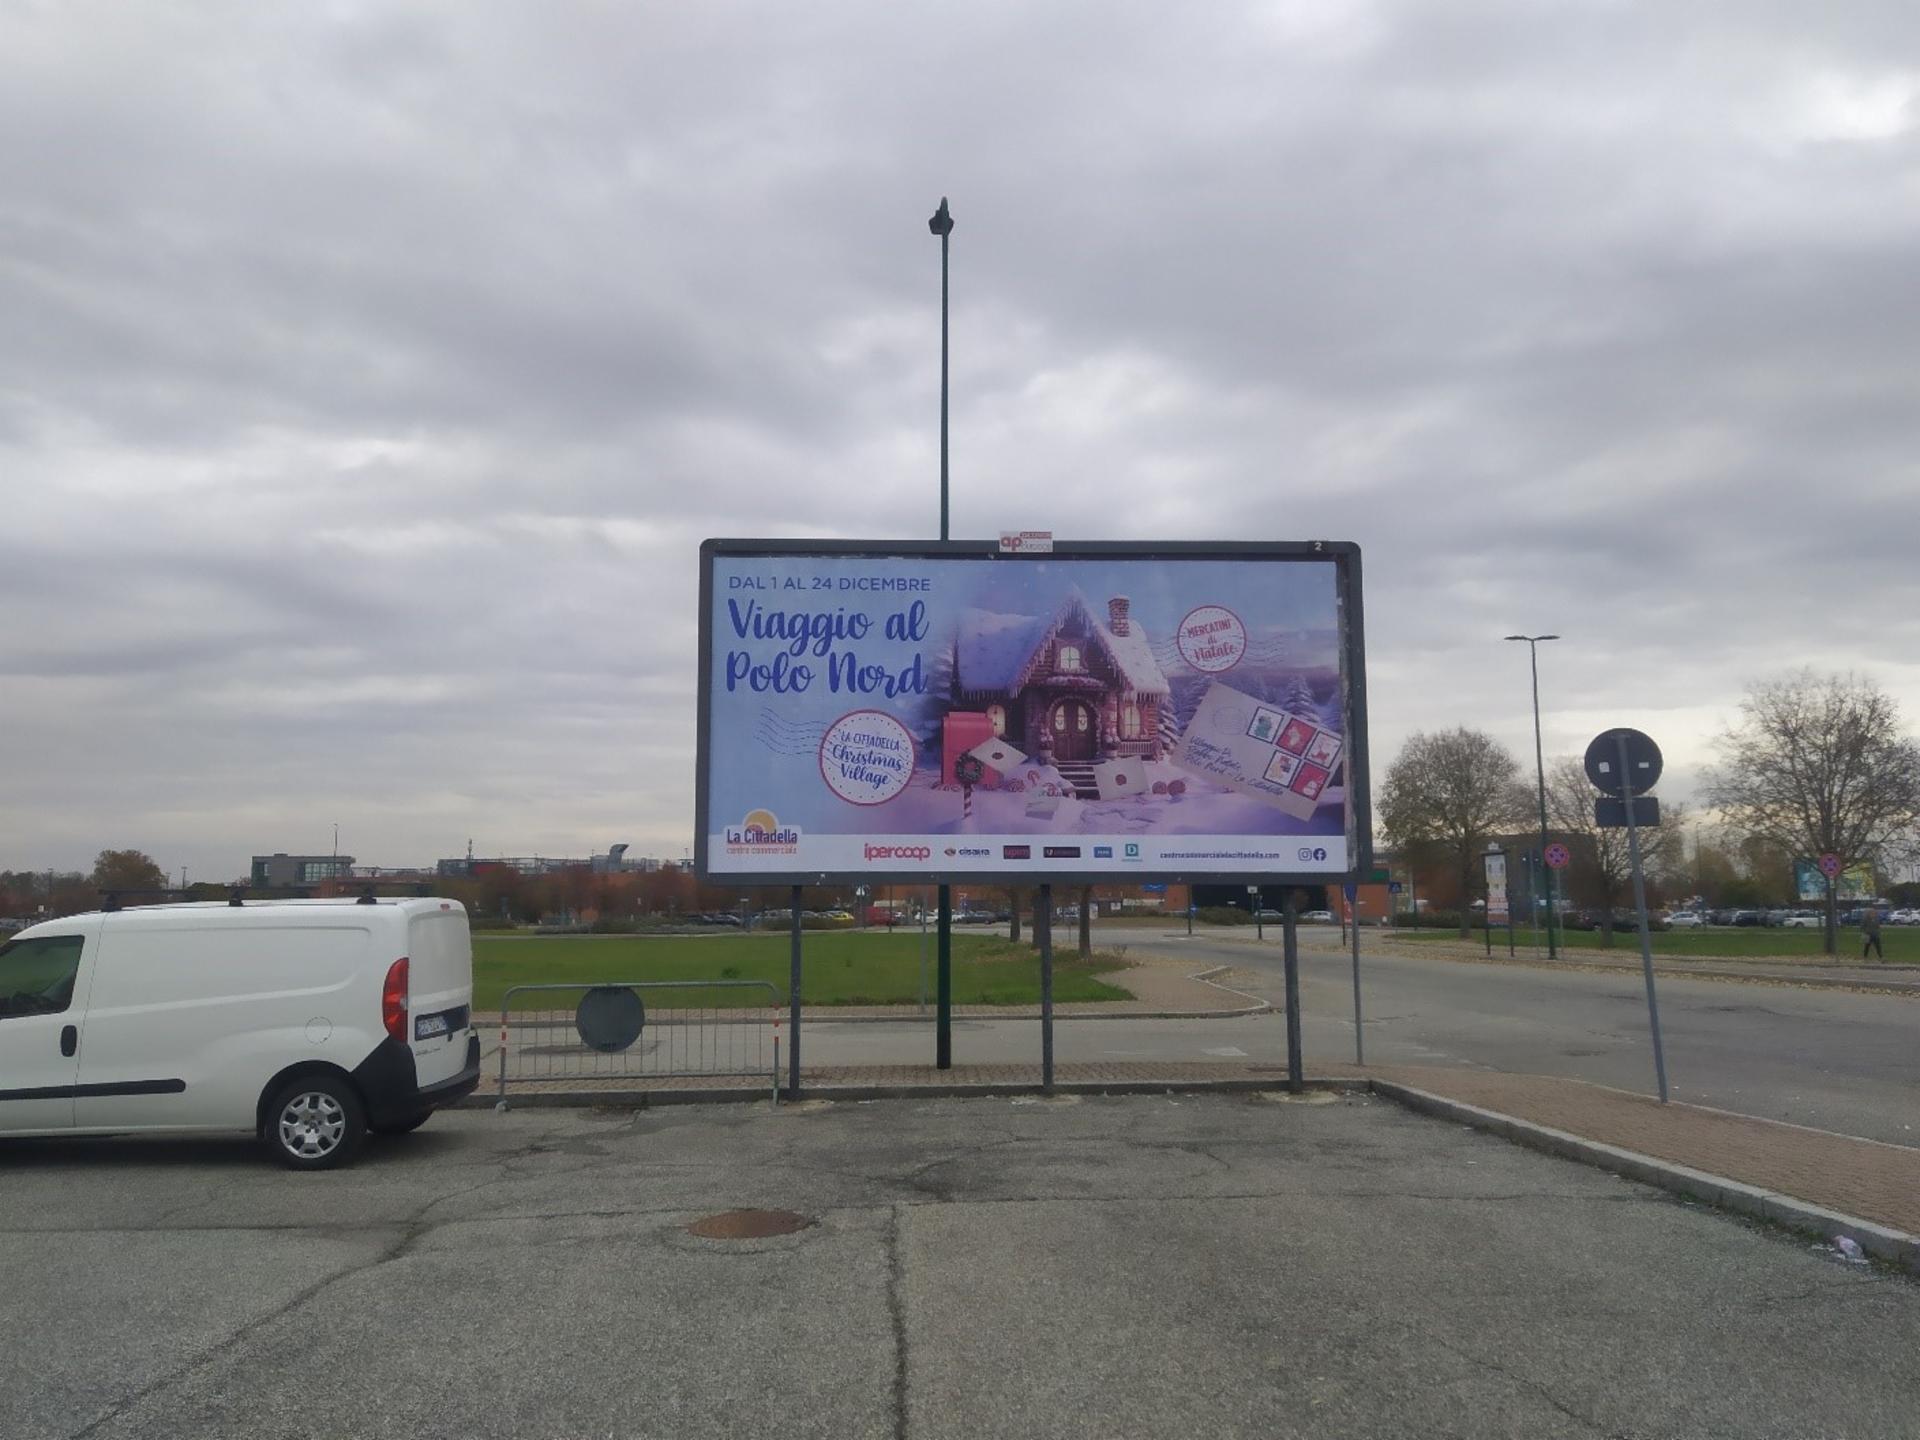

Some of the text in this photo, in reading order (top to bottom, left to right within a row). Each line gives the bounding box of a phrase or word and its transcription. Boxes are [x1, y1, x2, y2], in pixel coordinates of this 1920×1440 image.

[729, 576, 931, 591] DAL 1 AL 24 DICEMBRE
[727, 598, 930, 657] Viaggio al
[1187, 618, 1231, 638] MERCATINI
[1193, 642, 1234, 663] Natale
[726, 651, 928, 699] Polo Nord
[840, 730, 899, 751] LA CITTADELLA
[832, 744, 902, 771] Christmas
[841, 763, 890, 790] Village
[727, 828, 798, 844] La Cittadella
[864, 843, 931, 861] ipercoop
